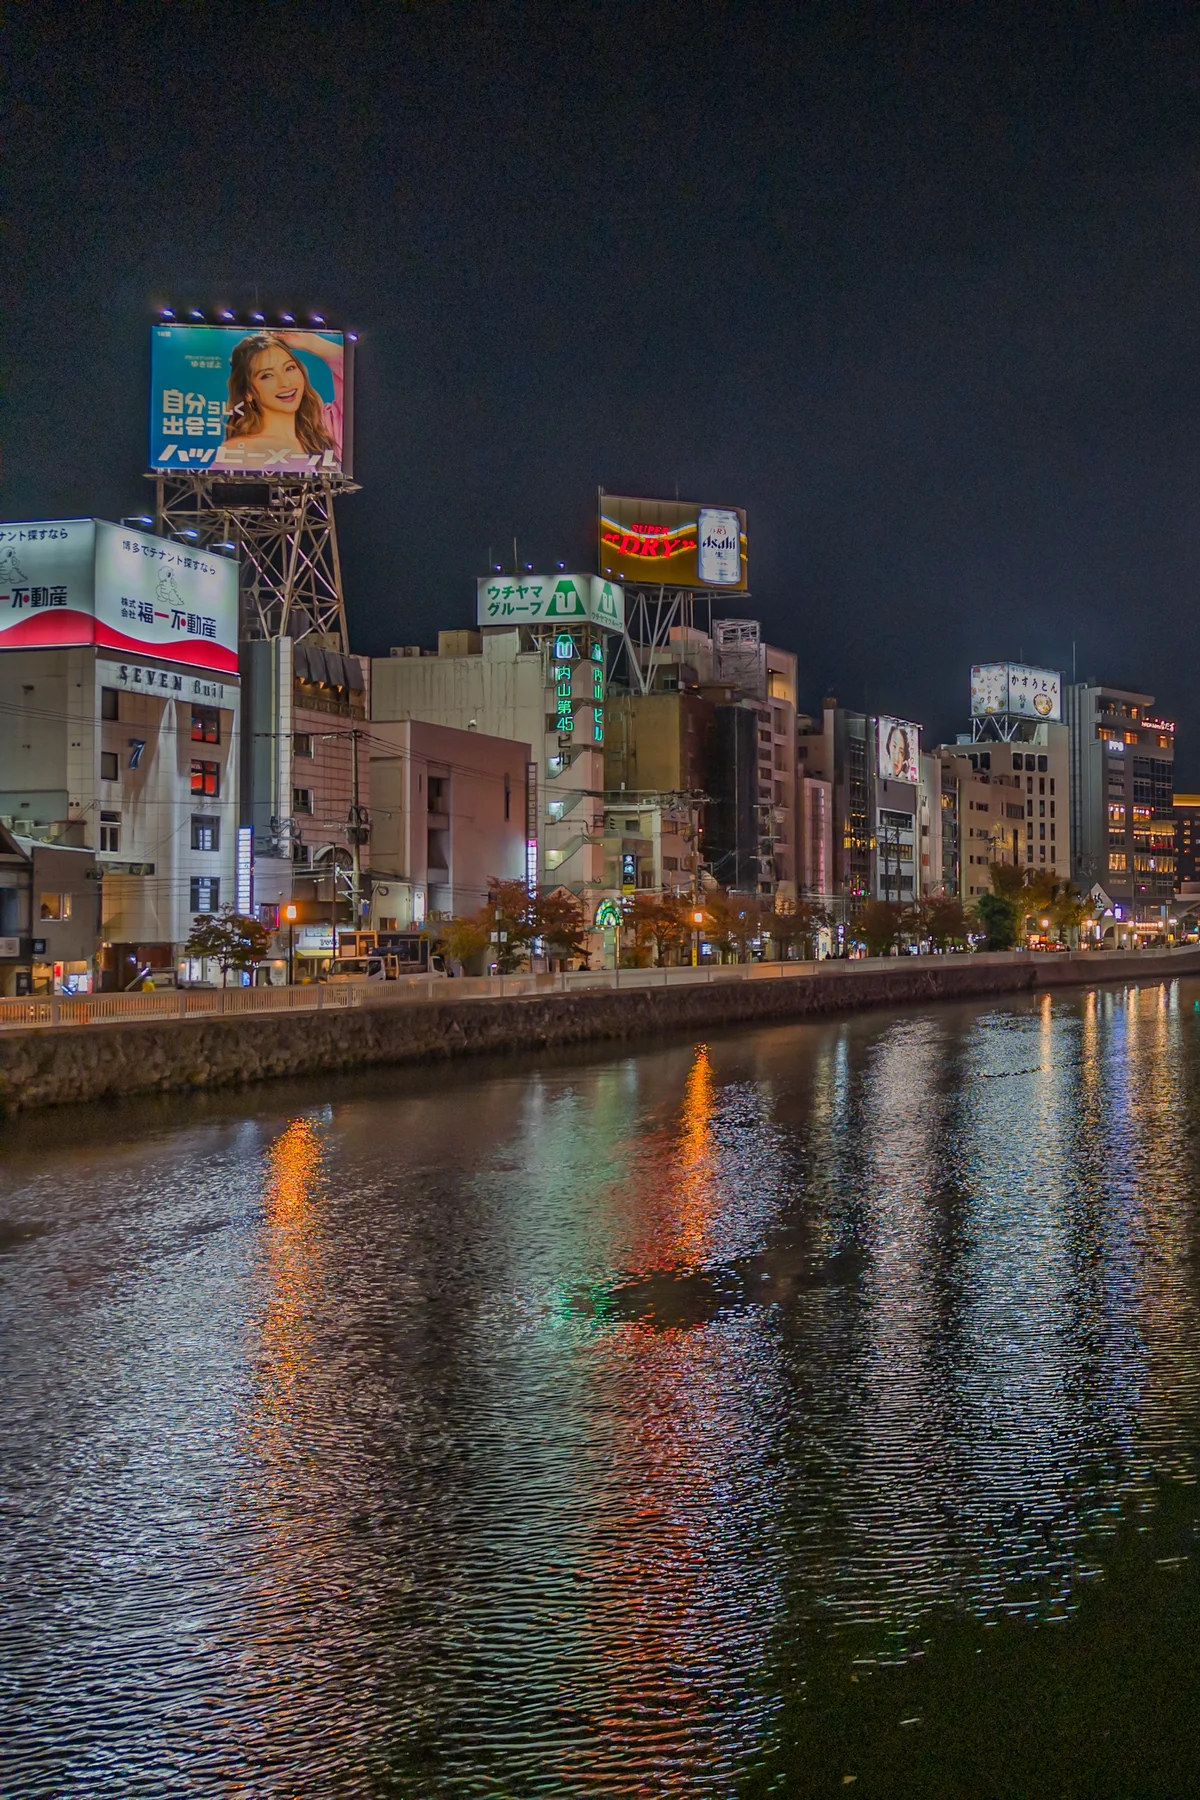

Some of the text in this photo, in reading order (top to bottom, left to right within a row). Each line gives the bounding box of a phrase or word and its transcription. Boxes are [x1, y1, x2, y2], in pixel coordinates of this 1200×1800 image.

[163, 389, 244, 416] 自分らしく
[162, 415, 221, 435] 出会う
[158, 442, 337, 467] ハッピーメール
[631, 523, 670, 535] SUPER
[702, 535, 736, 550] Asahi
[122, 540, 216, 575] 博多でテナント探すなら
[487, 585, 543, 600] ウチヤマ
[487, 601, 544, 617] グループ
[137, 601, 216, 638] 福一不動産
[591, 611, 623, 630] ウチヤマグループ
[118, 665, 182, 692] SEVEN
